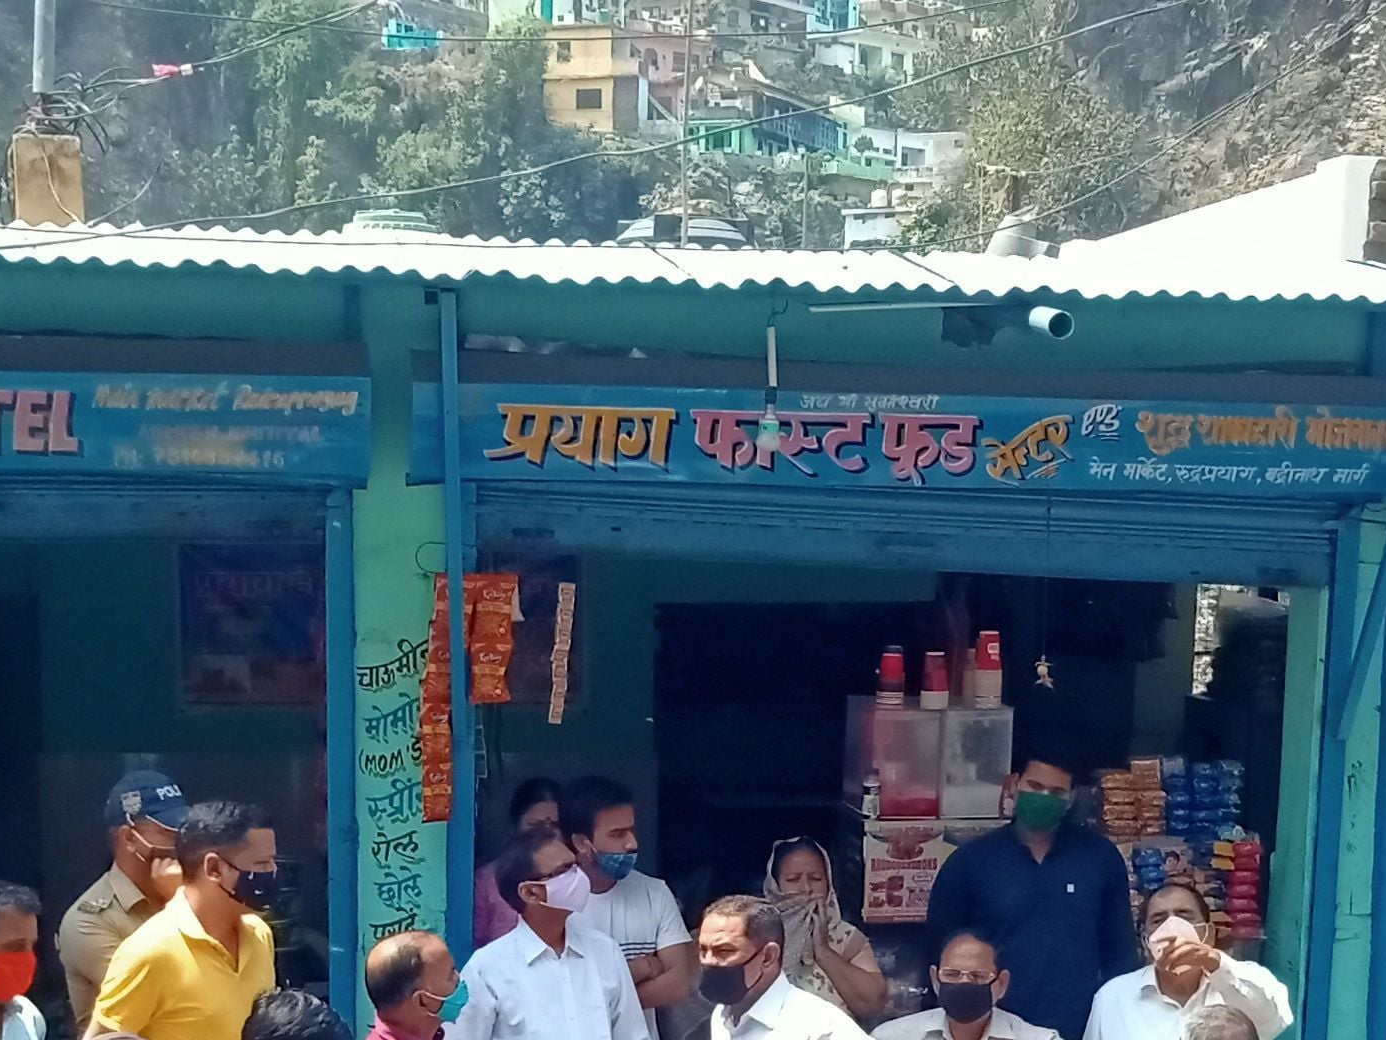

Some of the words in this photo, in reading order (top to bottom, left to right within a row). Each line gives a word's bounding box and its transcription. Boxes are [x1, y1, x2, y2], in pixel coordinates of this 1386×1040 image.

[484, 403, 678, 467] प्रयाग
[690, 408, 871, 477] फास्ट
[876, 411, 981, 486] फूड
[1088, 456, 1116, 481] मेन
[1332, 462, 1370, 486] मार्ग
[372, 830, 419, 868] रोल
